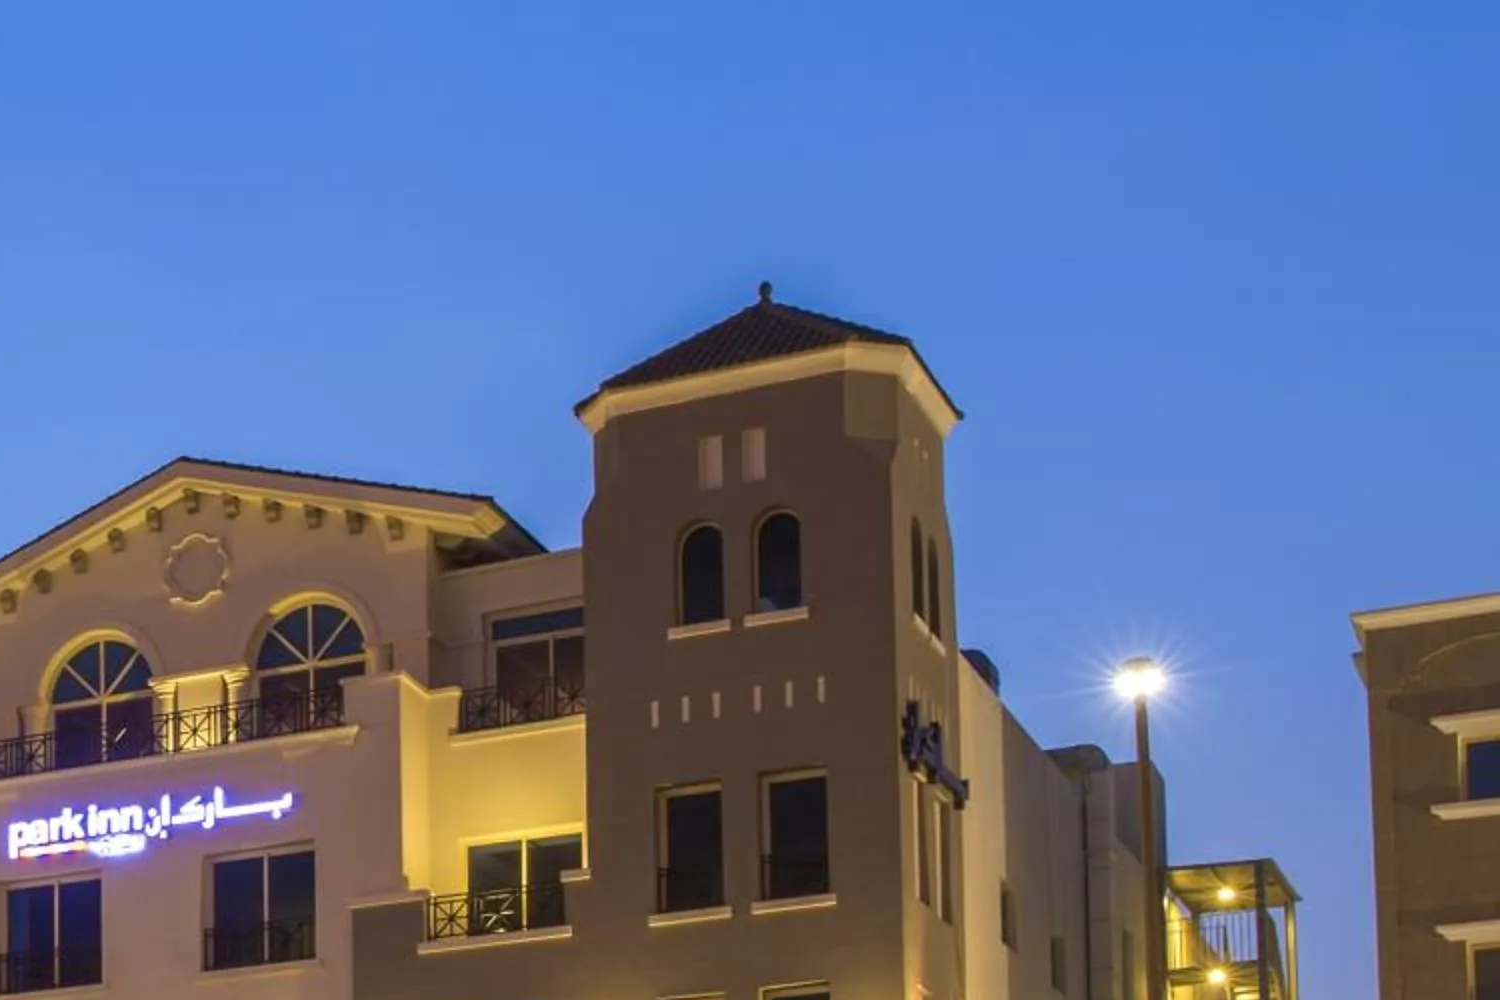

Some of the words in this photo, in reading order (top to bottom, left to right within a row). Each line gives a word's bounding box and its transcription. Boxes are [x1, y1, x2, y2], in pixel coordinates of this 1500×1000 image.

[8, 806, 85, 859] park
[87, 804, 143, 837] inn
[171, 786, 293, 830] بارك
